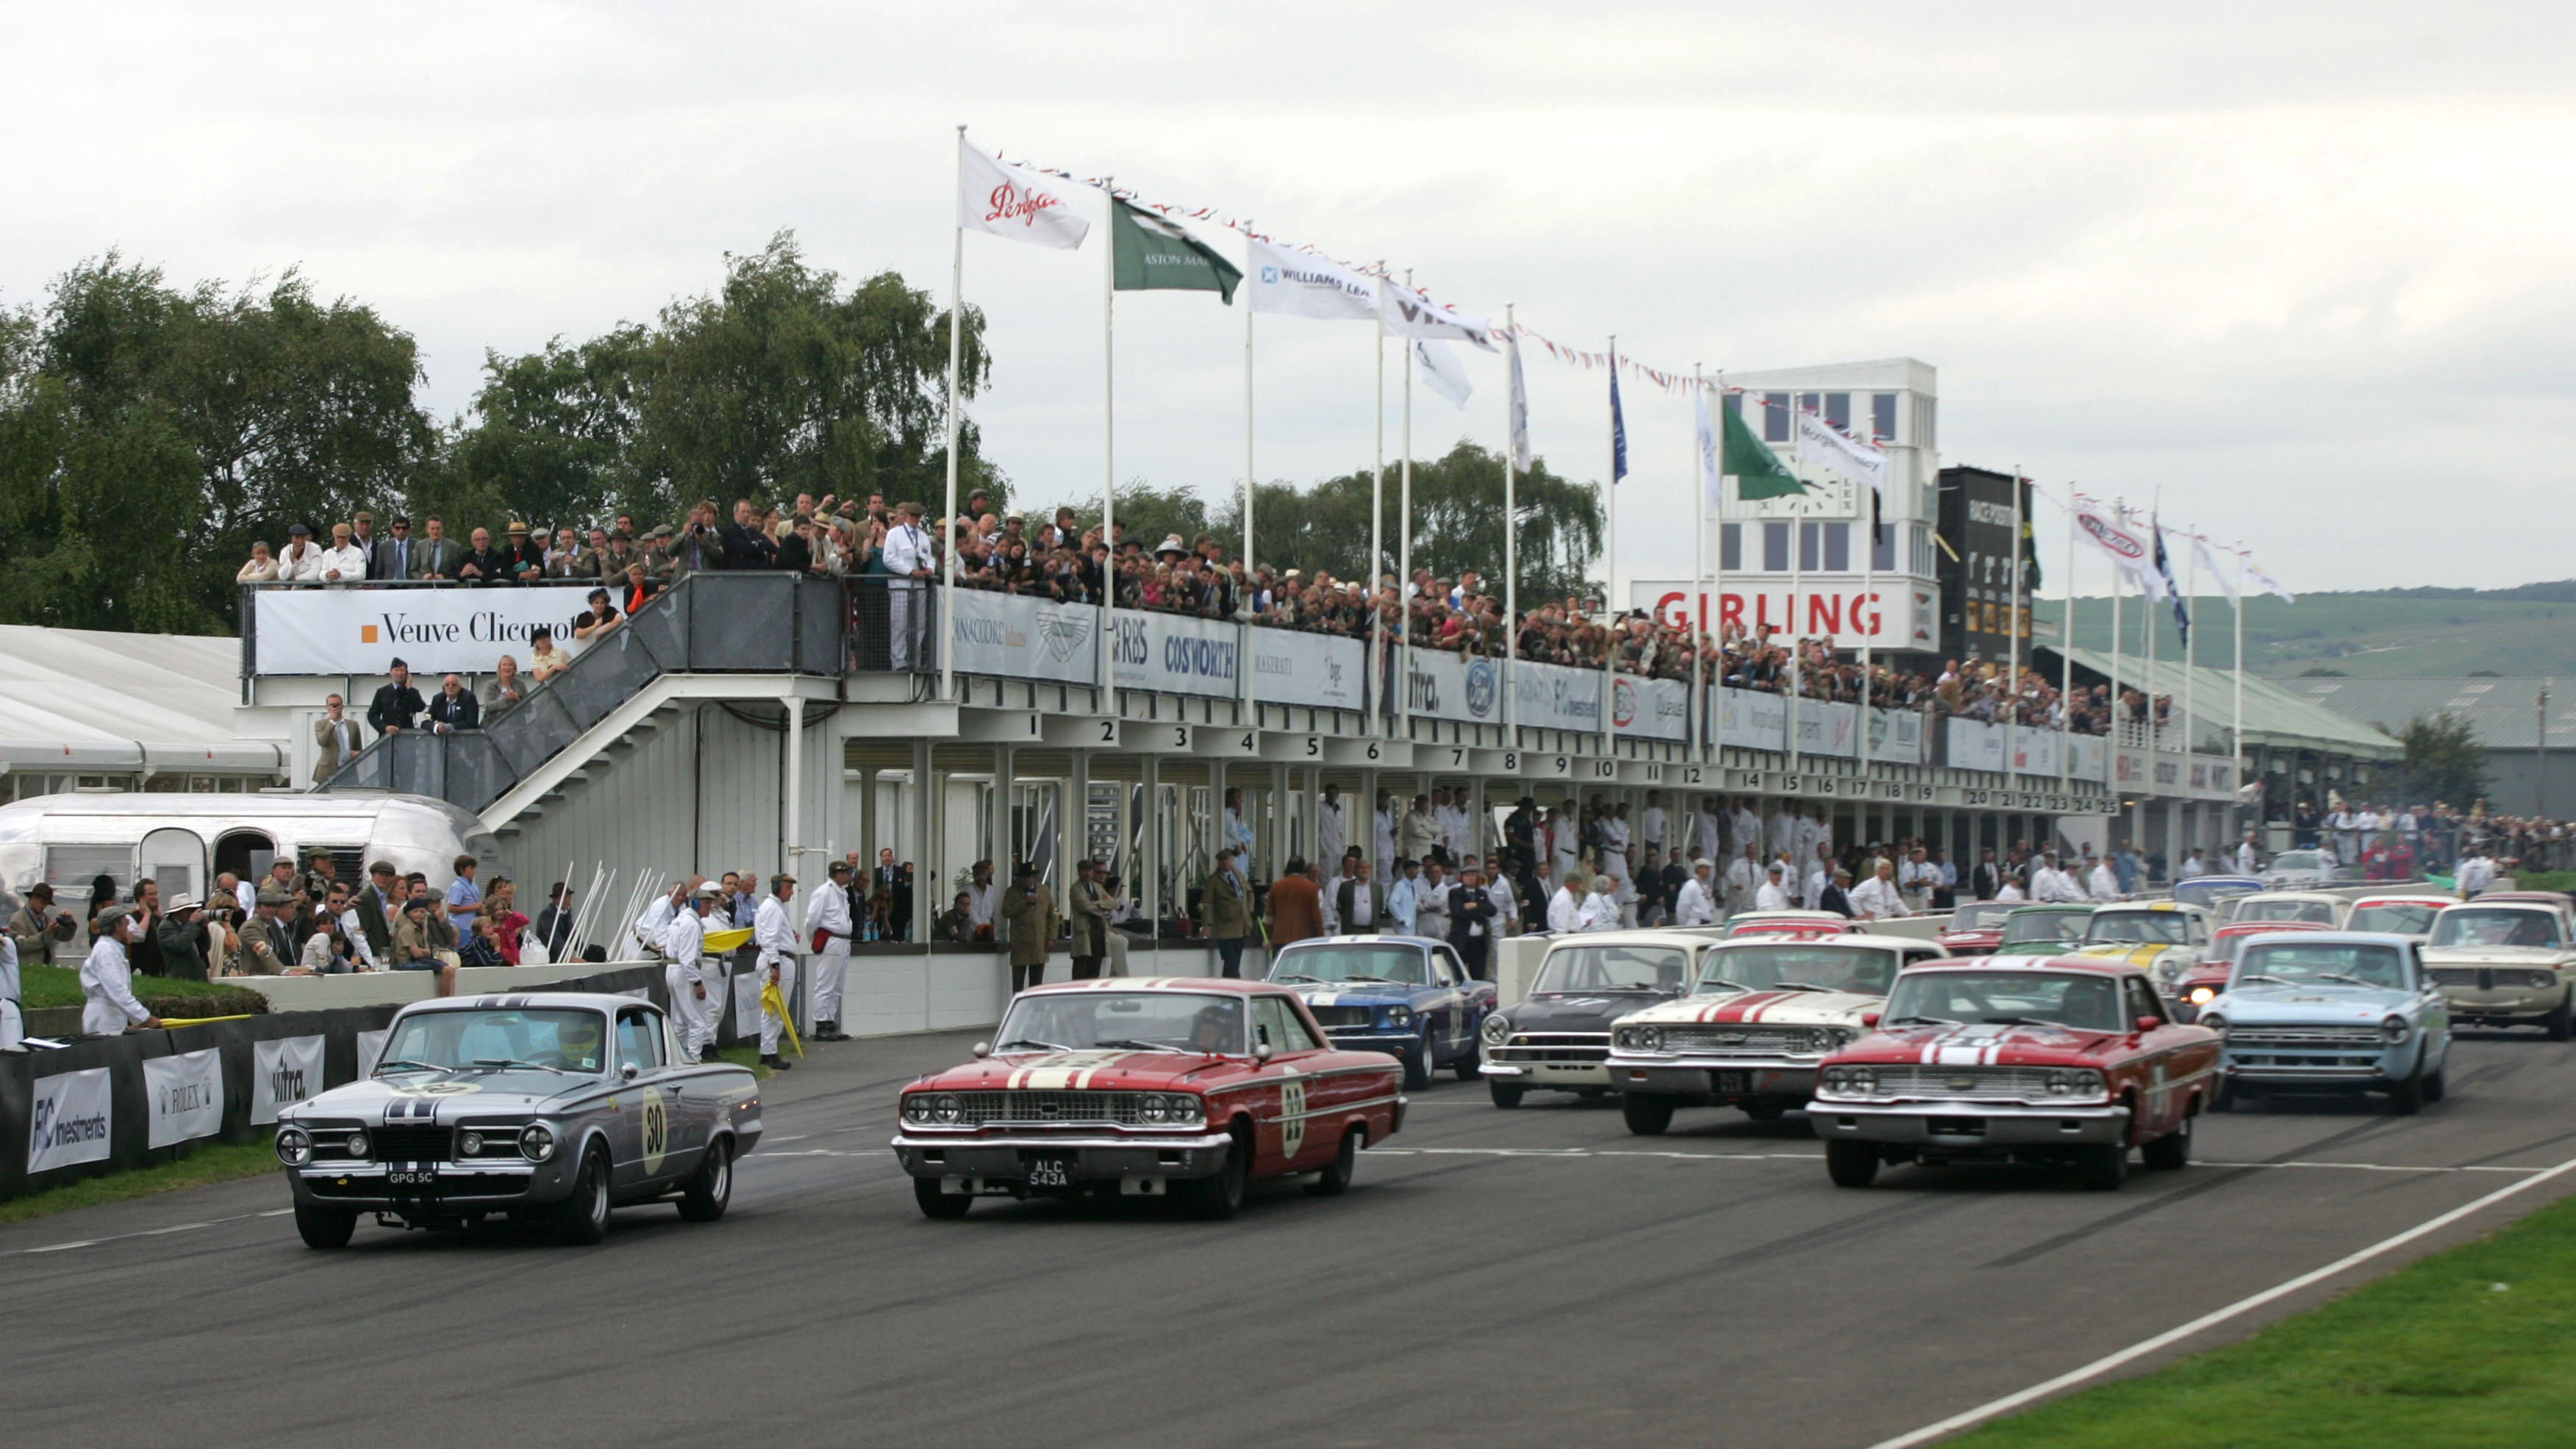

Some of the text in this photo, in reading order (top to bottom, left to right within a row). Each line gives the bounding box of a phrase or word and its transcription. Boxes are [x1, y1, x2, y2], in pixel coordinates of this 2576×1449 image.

[1144, 254, 1181, 265] ASTON
[1282, 268, 1342, 289] WILLIAMS
[1656, 591, 1881, 636] GIRLING
[381, 613, 459, 644] Veuve
[1123, 617, 1148, 665] RBS
[1164, 634, 1234, 679] COSWORTH
[1254, 654, 1292, 676] MASERATI
[1031, 715, 1037, 734] 1
[1101, 722, 1114, 741] 2
[1176, 728, 1187, 747] 3
[1241, 733, 1253, 751] 4
[1306, 737, 1318, 756] 5
[1367, 741, 1379, 759] 6
[1452, 749, 1463, 766] 7
[1505, 754, 1516, 770] 8
[1556, 757, 1567, 773] 9
[1595, 760, 1613, 777] 10
[1647, 765, 1659, 780] 11
[1684, 768, 1700, 784] 12
[1742, 773, 1759, 787] 14
[1782, 776, 1797, 790] 15
[1817, 779, 1833, 793] 16
[1852, 781, 1866, 795] 17
[1885, 784, 1900, 798] 18
[1917, 787, 1932, 800] 19
[1969, 792, 1987, 804] 20
[2003, 795, 2016, 806] 21
[2024, 795, 2042, 808] 22
[2051, 798, 2068, 809] 23
[2075, 800, 2092, 811] 24
[2100, 801, 2116, 813] 25
[273, 1053, 306, 1103] vitra.
[172, 1084, 200, 1115] ROLEX
[647, 1104, 663, 1154] 30
[1035, 1160, 1063, 1173] ALC
[390, 1171, 434, 1184] GPG 5C
[1030, 1173, 1067, 1186] 543A
